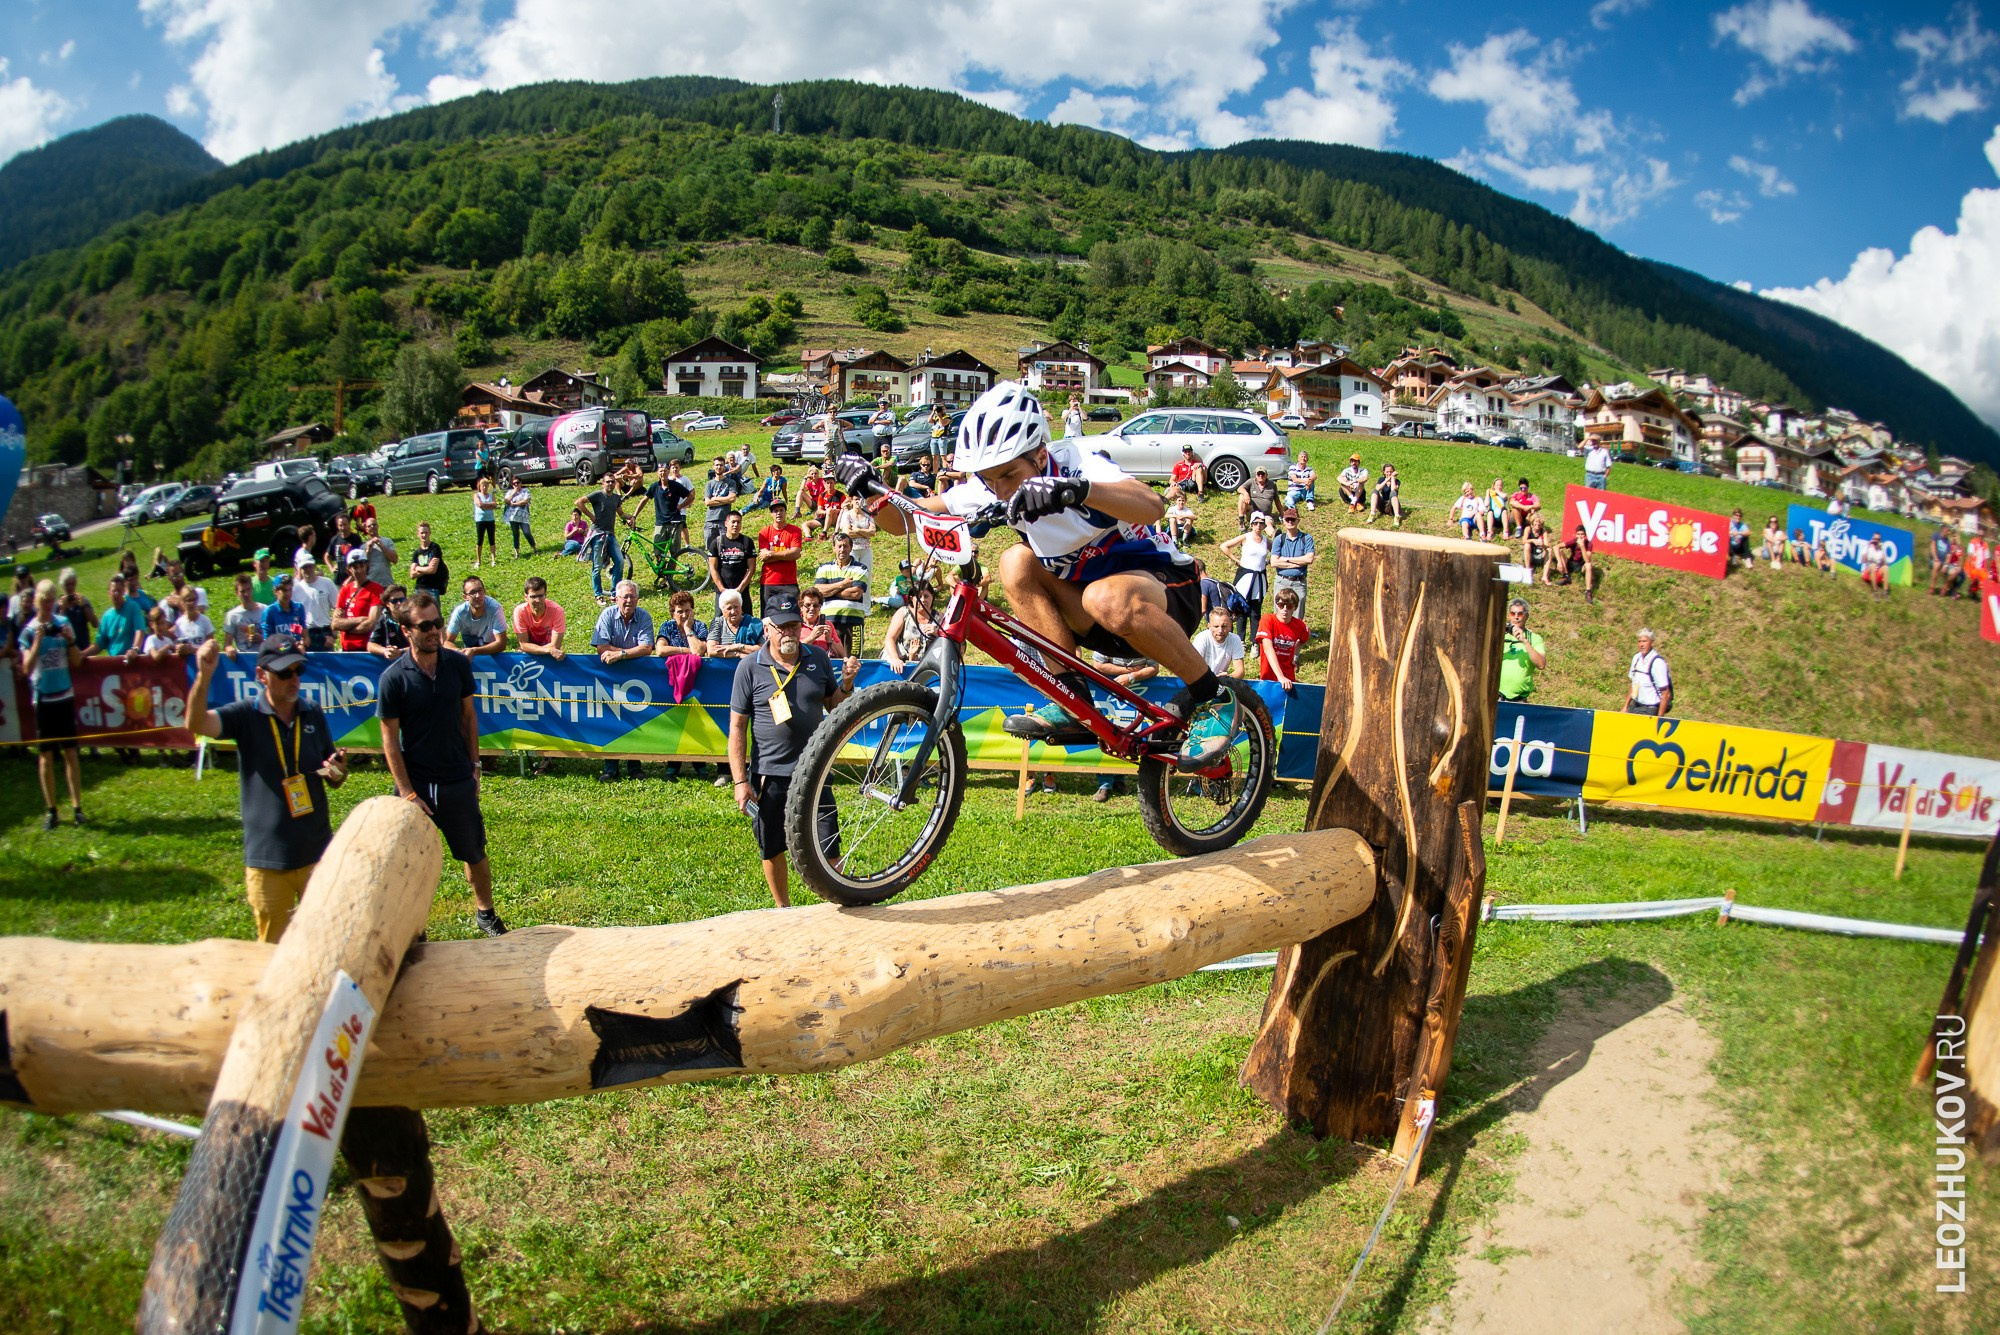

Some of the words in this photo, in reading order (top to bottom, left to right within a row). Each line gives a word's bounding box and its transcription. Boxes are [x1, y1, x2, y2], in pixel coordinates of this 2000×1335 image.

[925, 528, 958, 551] 303
[1576, 500, 1624, 543] Val
[1626, 523, 1648, 546] di
[1649, 510, 1719, 554] Sole
[1809, 519, 1898, 565] TRENTO
[851, 625, 861, 655] SPRING
[1015, 649, 1056, 685] MD-Bavaria
[227, 671, 375, 717] TRTINO
[473, 671, 652, 723] TRENTINO
[1626, 738, 1808, 802] Melinda
[1915, 790, 1936, 816] di
[1935, 771, 1994, 822] Sole
[326, 1013, 363, 1083] Sole
[330, 1072, 345, 1102] di
[302, 1091, 339, 1141] Val
[258, 1168, 317, 1323] TRENTINO
